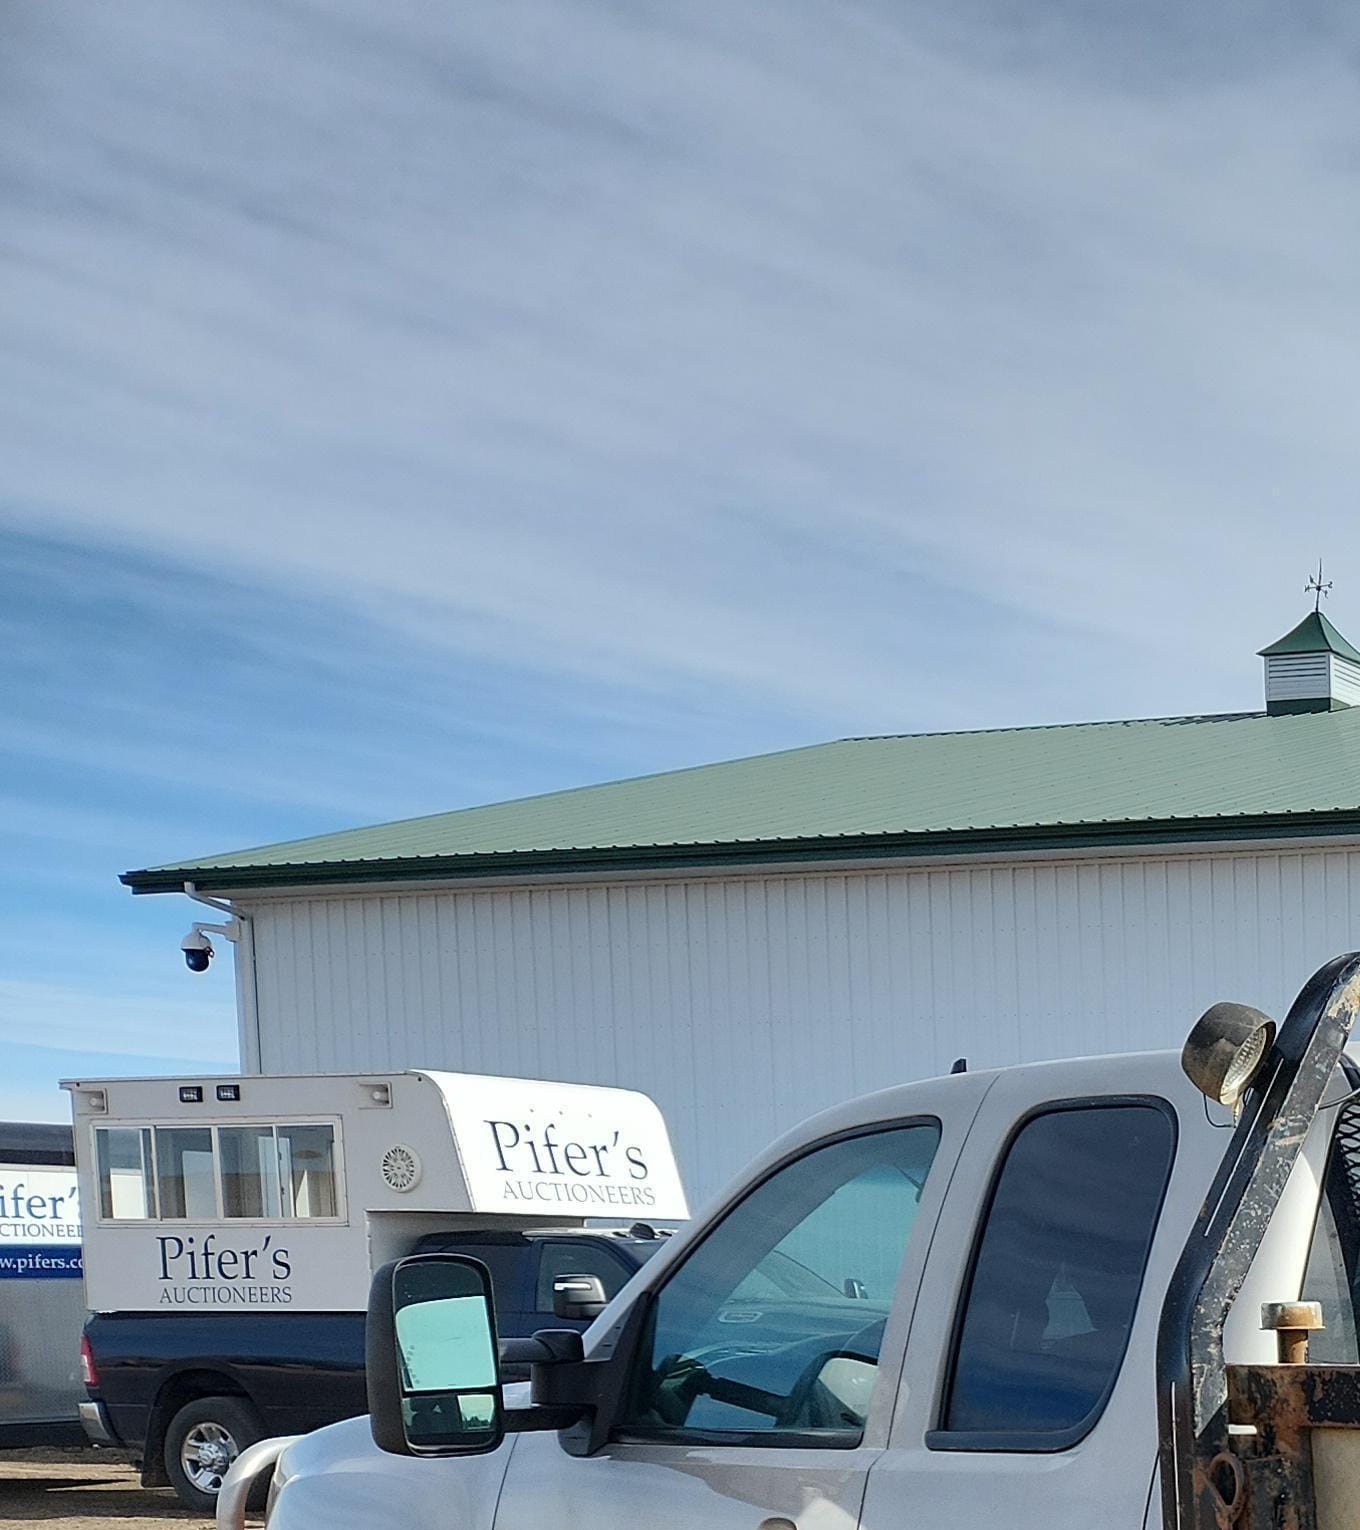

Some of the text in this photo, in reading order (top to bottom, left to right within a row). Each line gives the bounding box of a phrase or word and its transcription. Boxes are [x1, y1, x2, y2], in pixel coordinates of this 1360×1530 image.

[483, 1119, 649, 1180] Pifer's
[503, 1180, 657, 1206] AUCTIONEERS
[155, 1233, 292, 1281] Pifer's
[159, 1286, 293, 1304] AUCTIONEERS
